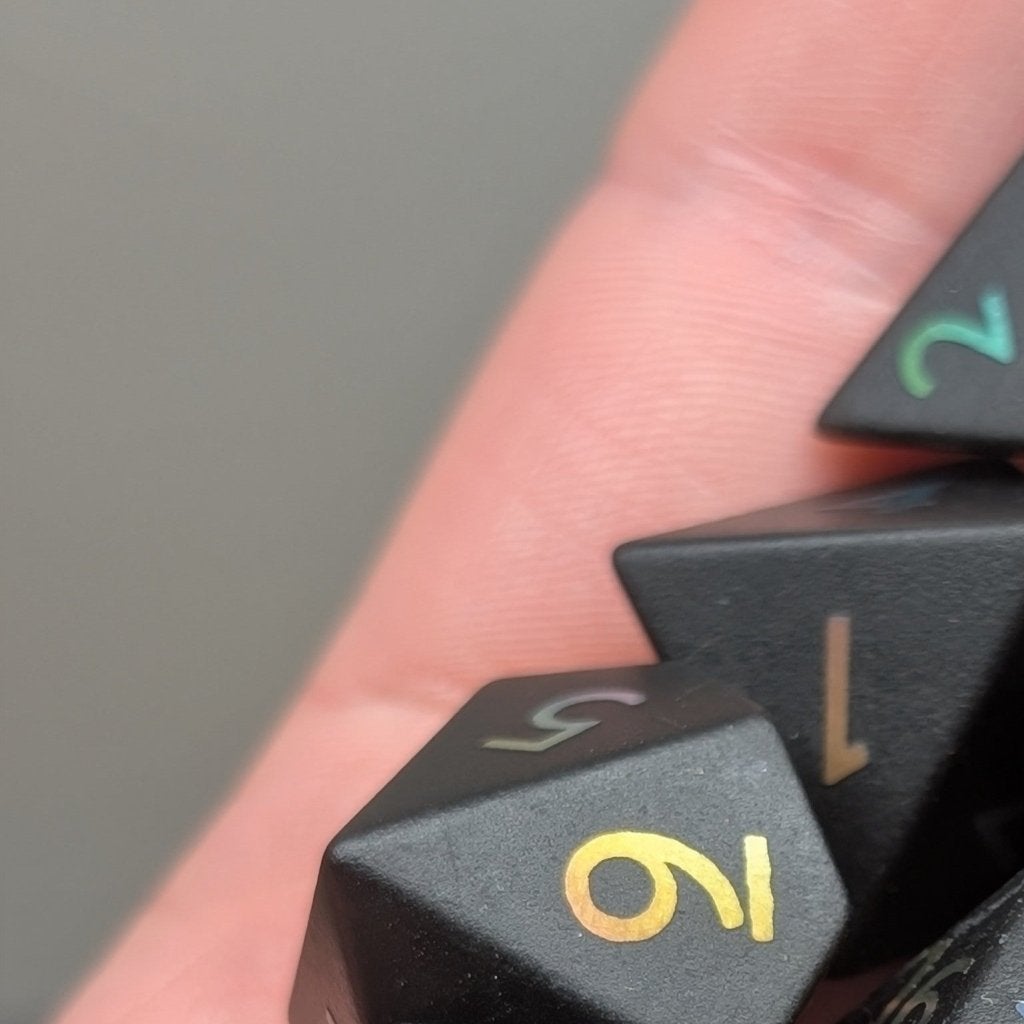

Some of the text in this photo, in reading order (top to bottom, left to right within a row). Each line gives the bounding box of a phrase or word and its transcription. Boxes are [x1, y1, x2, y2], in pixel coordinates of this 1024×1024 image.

[898, 286, 1016, 398] 2
[480, 688, 646, 752] 5
[823, 612, 870, 787] 1
